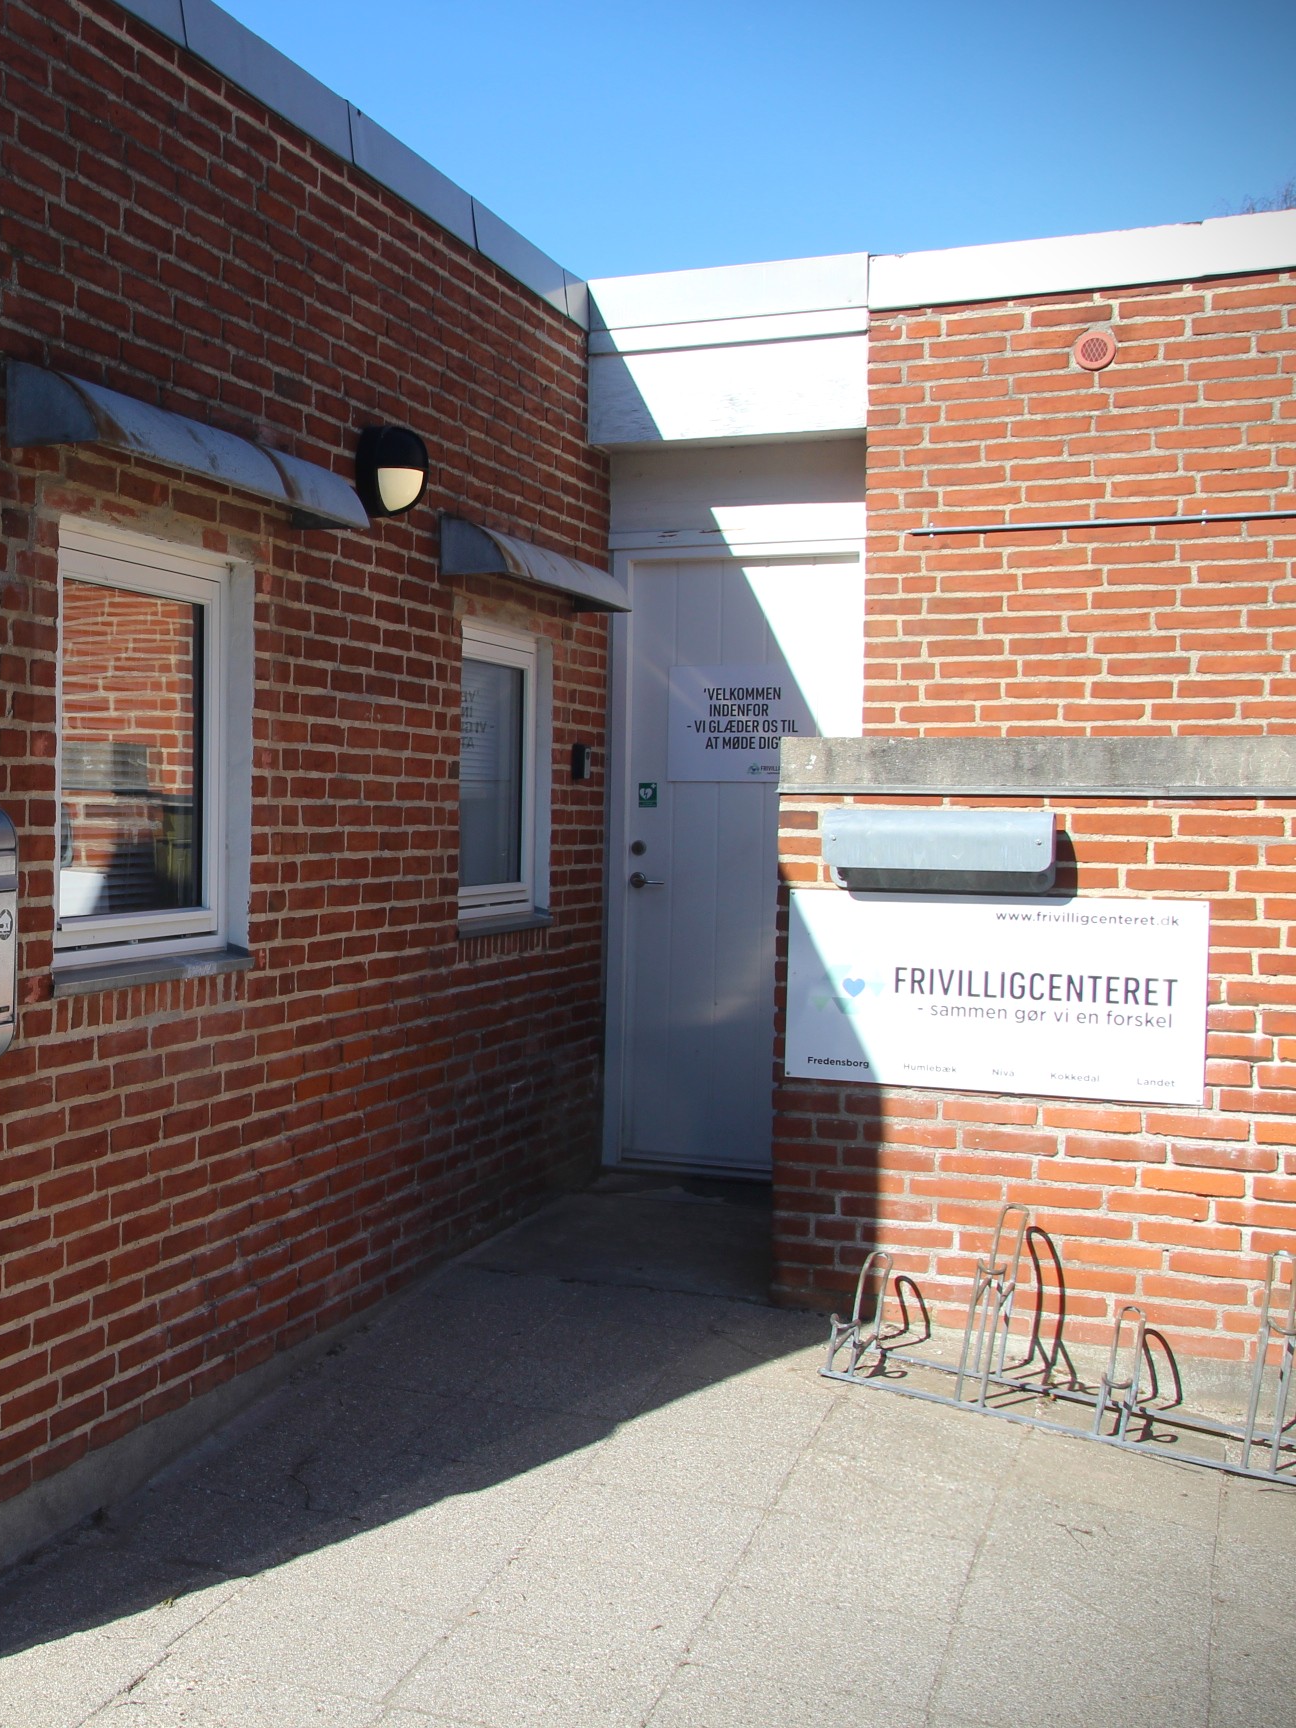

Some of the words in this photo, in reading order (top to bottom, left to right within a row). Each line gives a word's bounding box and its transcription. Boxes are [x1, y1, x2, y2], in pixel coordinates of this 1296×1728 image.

[709, 703, 769, 717] INDENFOR
[694, 720, 706, 733] VI
[709, 720, 759, 733] GLÆDER
[762, 719, 778, 733] OS
[781, 719, 798, 733] TIL
[705, 736, 720, 750] AT
[722, 736, 756, 750] MØDE
[995, 911, 1180, 927] www.frivilligcenteret.dk
[894, 966, 1178, 1007] FRIVILLIGCENTERET
[930, 1004, 1007, 1020] sammen
[1015, 1009, 1046, 1024] gør
[1054, 1008, 1069, 1023] vi
[1076, 1011, 1099, 1025] en
[1106, 1010, 1172, 1028] forskel
[807, 1056, 870, 1069] Fredensborg
[904, 1063, 957, 1073] Humlebæk
[1050, 1072, 1100, 1083] Kokkedal
[1136, 1078, 1175, 1088] Landet
